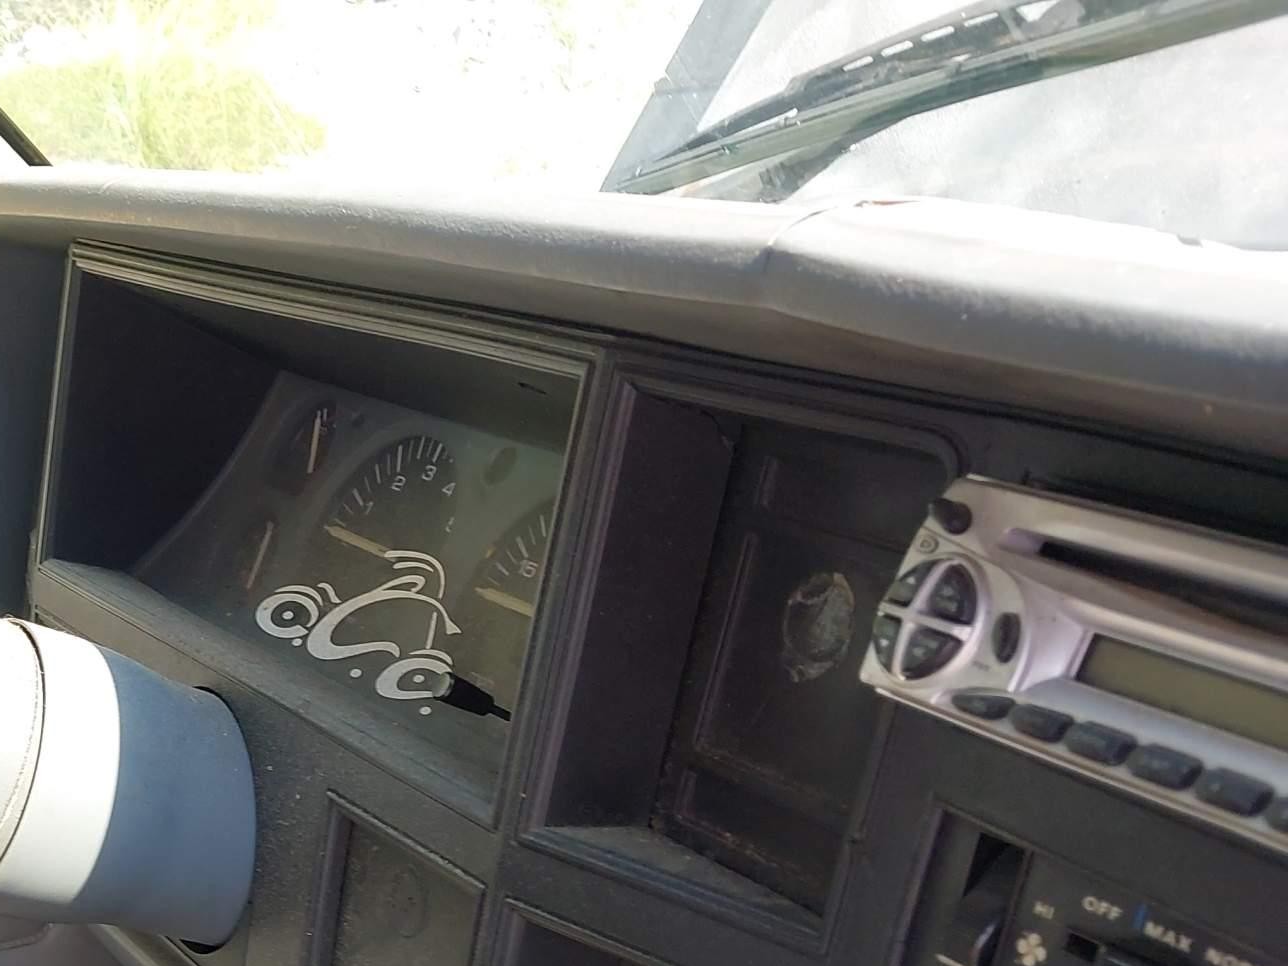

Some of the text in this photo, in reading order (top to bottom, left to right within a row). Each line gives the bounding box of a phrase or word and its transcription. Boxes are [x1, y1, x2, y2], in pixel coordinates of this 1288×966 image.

[391, 475, 407, 492] 2
[421, 464, 437, 481] 3
[1033, 901, 1055, 920] HI
[1081, 896, 1123, 920] OFF
[1144, 921, 1192, 953] MAX
